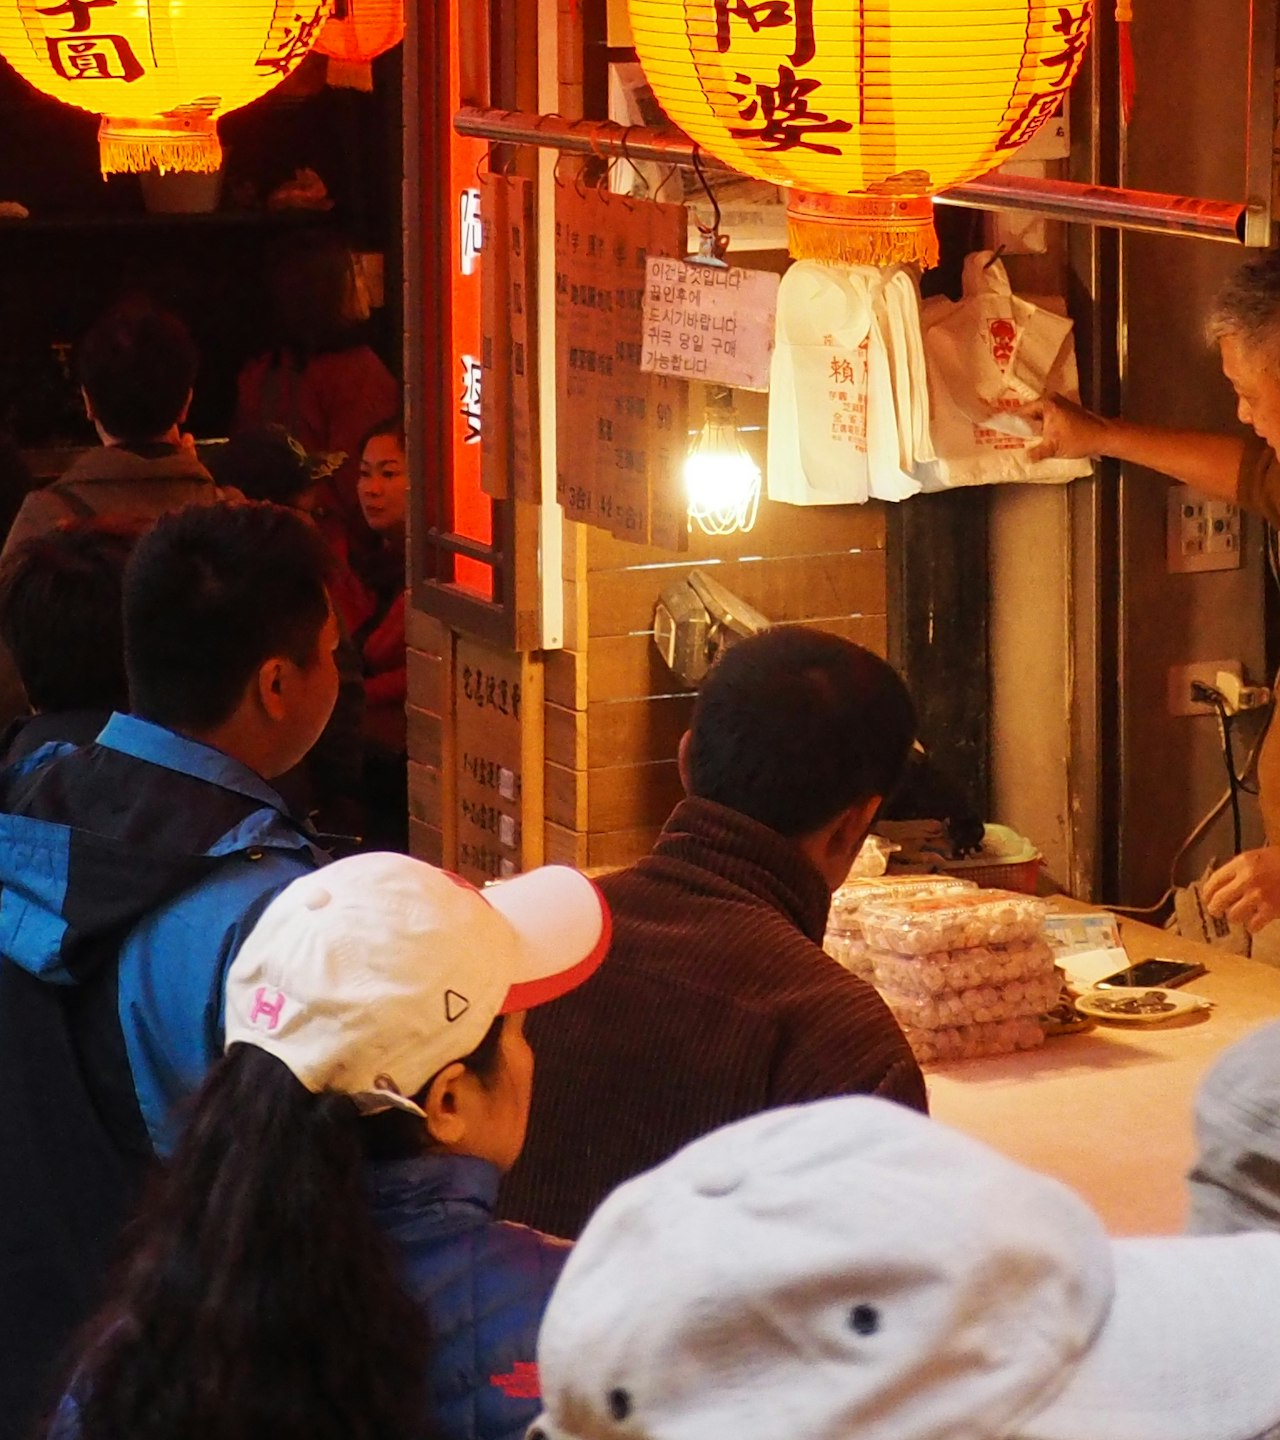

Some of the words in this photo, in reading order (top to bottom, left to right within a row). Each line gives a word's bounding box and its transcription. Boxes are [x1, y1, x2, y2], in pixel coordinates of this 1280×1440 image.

[648, 307, 738, 335] 드시기바랍니다
[679, 333, 705, 352] 당일
[711, 337, 737, 358] 구매
[646, 350, 708, 374] 가능합니다
